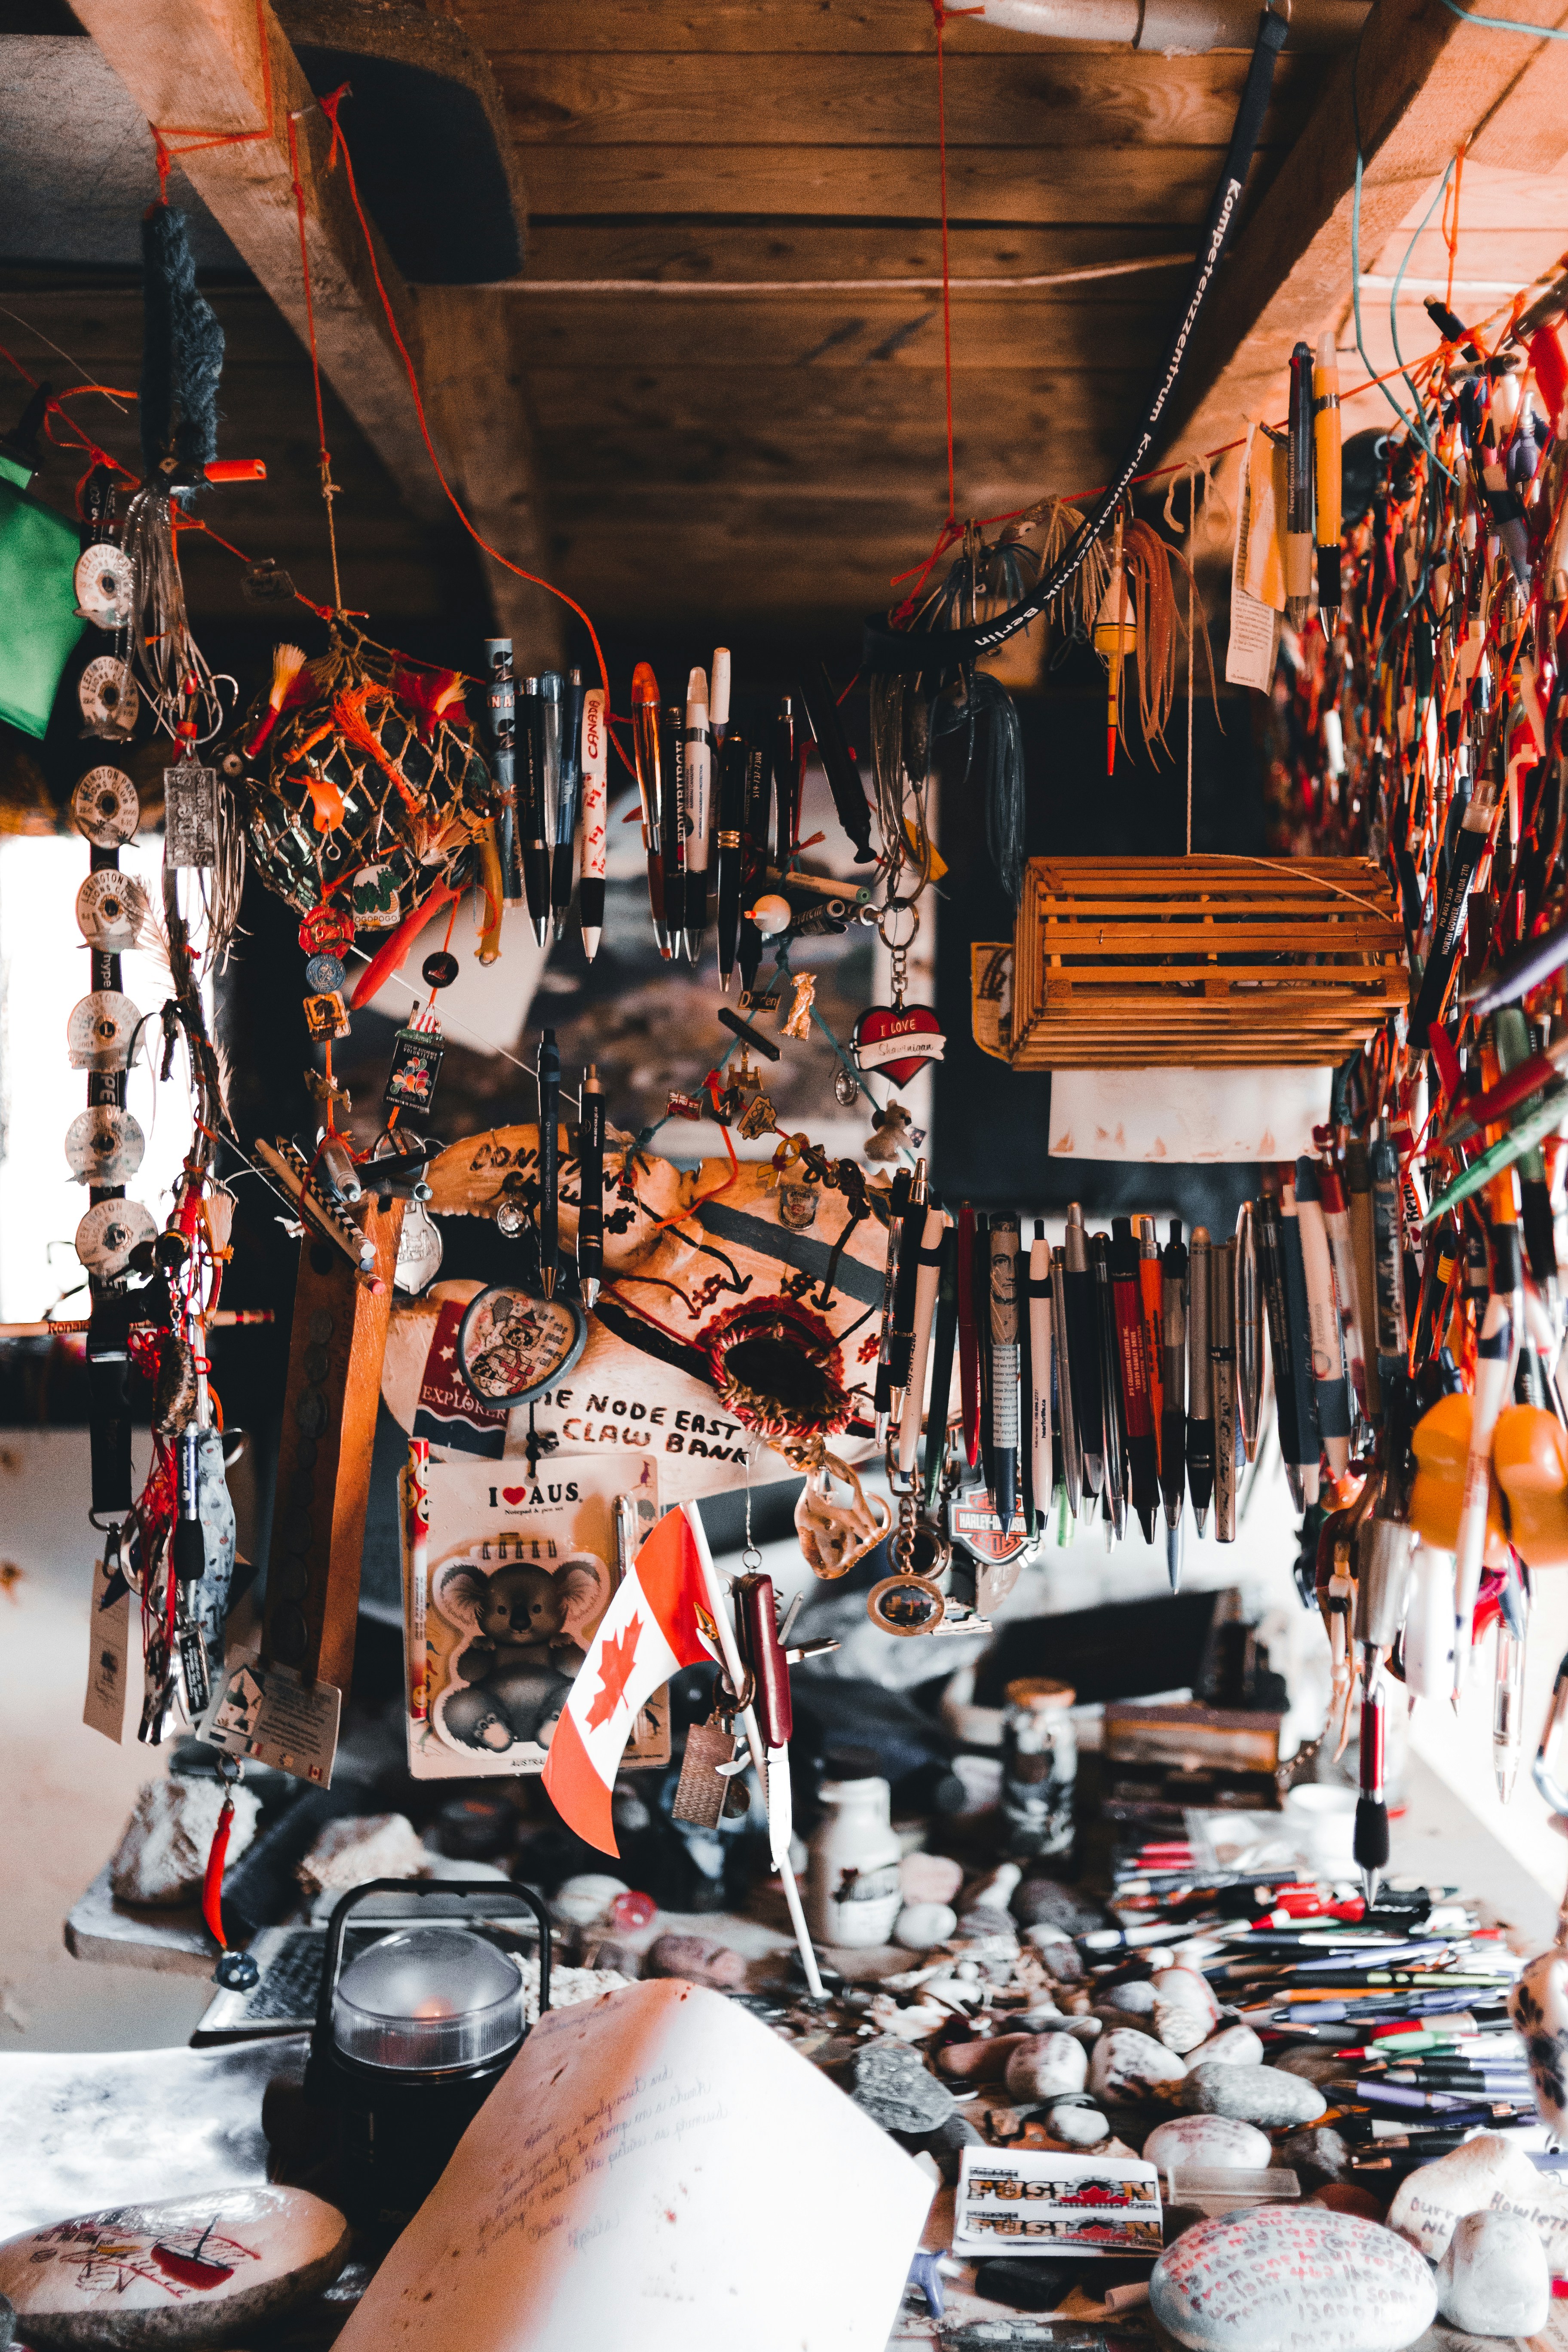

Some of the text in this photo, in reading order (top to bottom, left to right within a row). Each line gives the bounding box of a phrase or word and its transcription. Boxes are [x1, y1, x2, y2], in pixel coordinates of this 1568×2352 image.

[974, 178, 1242, 645] Kompetenzzentrum Kriminaltechnik Berlin
[588, 699, 601, 760] CANADA
[753, 752, 762, 799] 519-737-7308
[81, 873, 124, 903] LEXINGTON
[90, 884, 111, 906] LIONS
[1454, 893, 1463, 903] ON
[1439, 887, 1454, 928] PO BOX 338
[1447, 905, 1461, 931] GOWER,
[1441, 932, 1454, 955] NORTH
[100, 953, 113, 989] hype
[880, 1019, 916, 1037] I LOVE
[403, 1048, 437, 1061] VOLUNTEERS
[386, 1096, 404, 1105] STRENGTH
[887, 1246, 895, 1268] CLINIC
[1123, 1338, 1131, 1358] CENTER
[1125, 1359, 1134, 1387] COLLISION
[422, 1384, 508, 1421] EXPLORER
[586, 1394, 668, 1426] NODE
[675, 1409, 743, 1442] EAST
[562, 1417, 750, 1464] CLAW BANK
[489, 1486, 498, 1508] I
[504, 1507, 532, 1516] Notepad
[541, 1507, 554, 1515] pen
[967, 2175, 1156, 2203] FUSION
[965, 2216, 1161, 2240] FUSION
[1421, 2219, 1447, 2236] NL
